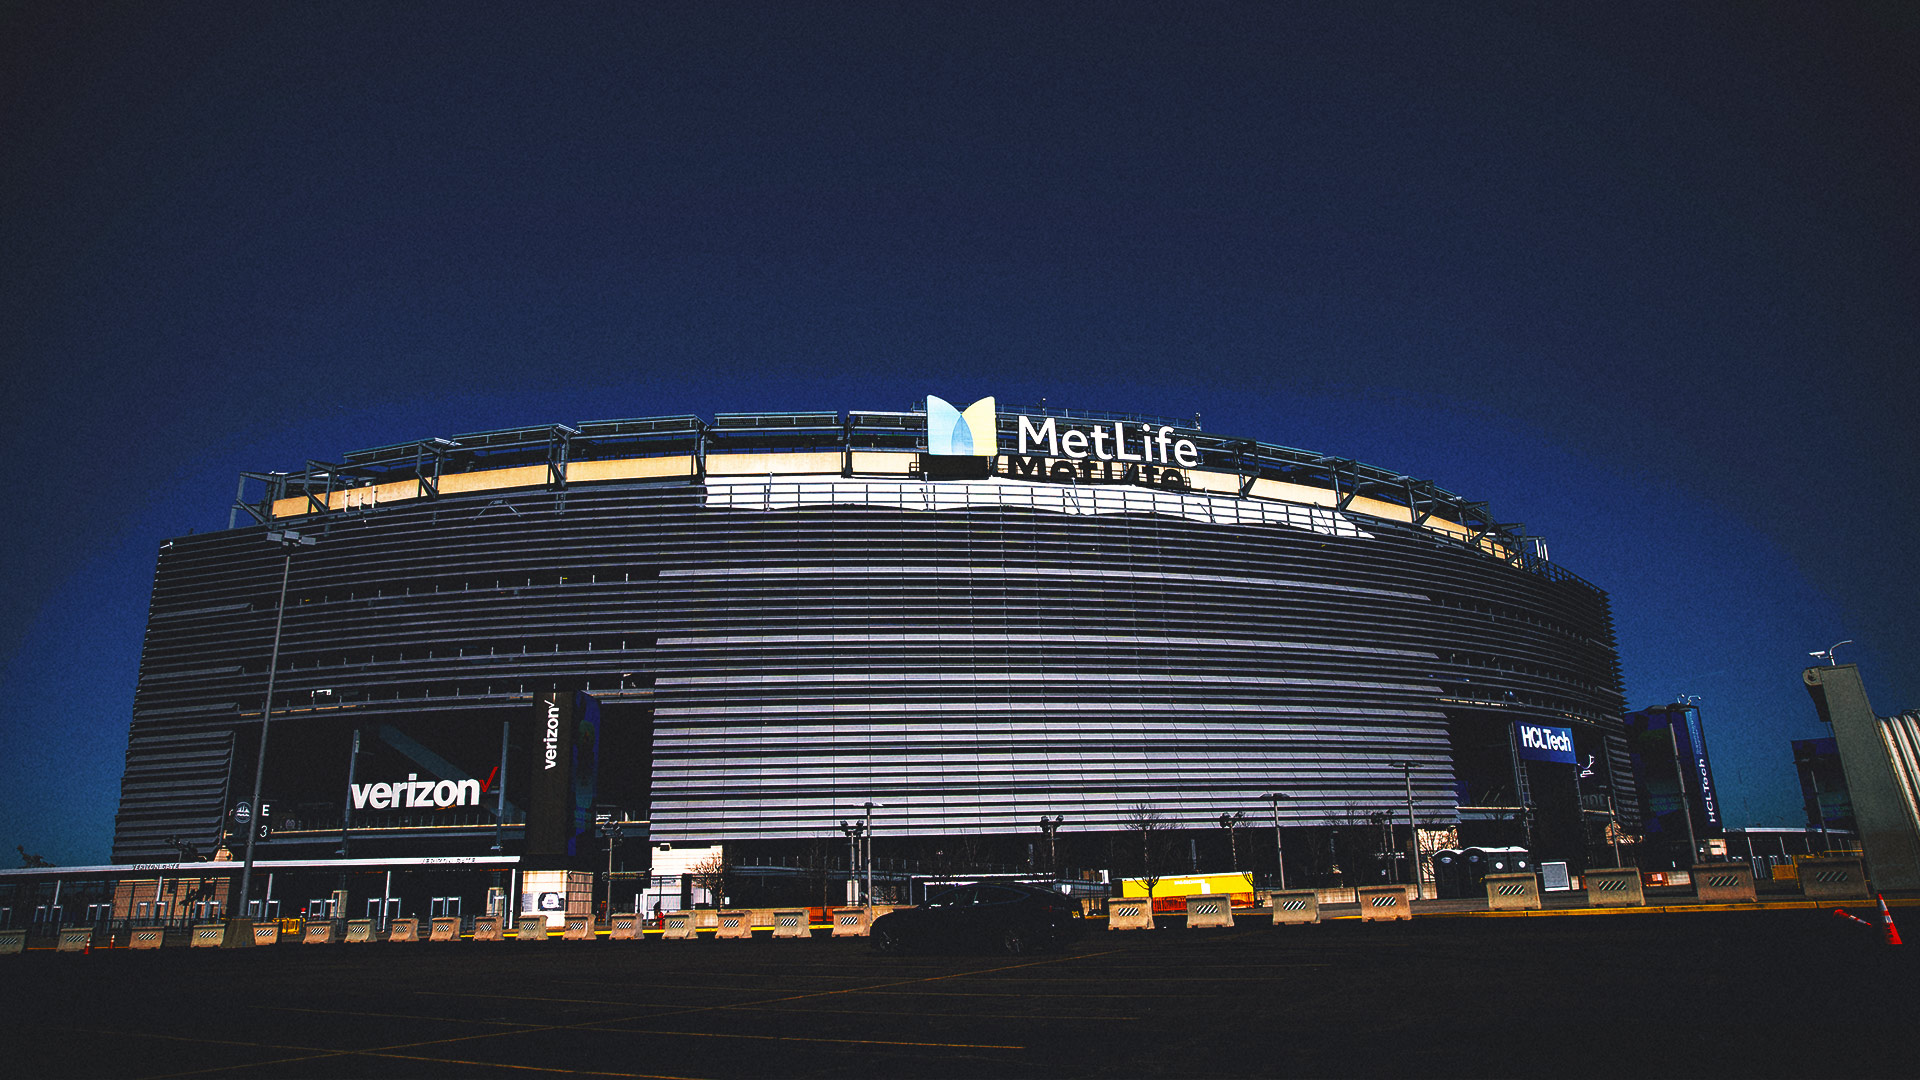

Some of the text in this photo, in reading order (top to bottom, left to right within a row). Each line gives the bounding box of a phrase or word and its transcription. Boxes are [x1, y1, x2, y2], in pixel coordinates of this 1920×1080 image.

[1018, 415, 1198, 469] MetLife
[543, 707, 560, 771] verizon
[1520, 725, 1572, 752] HCLTech
[350, 772, 481, 810] verizon
[1698, 758, 1717, 823] HCLTech
[261, 804, 271, 817] E
[259, 824, 268, 838] 3
